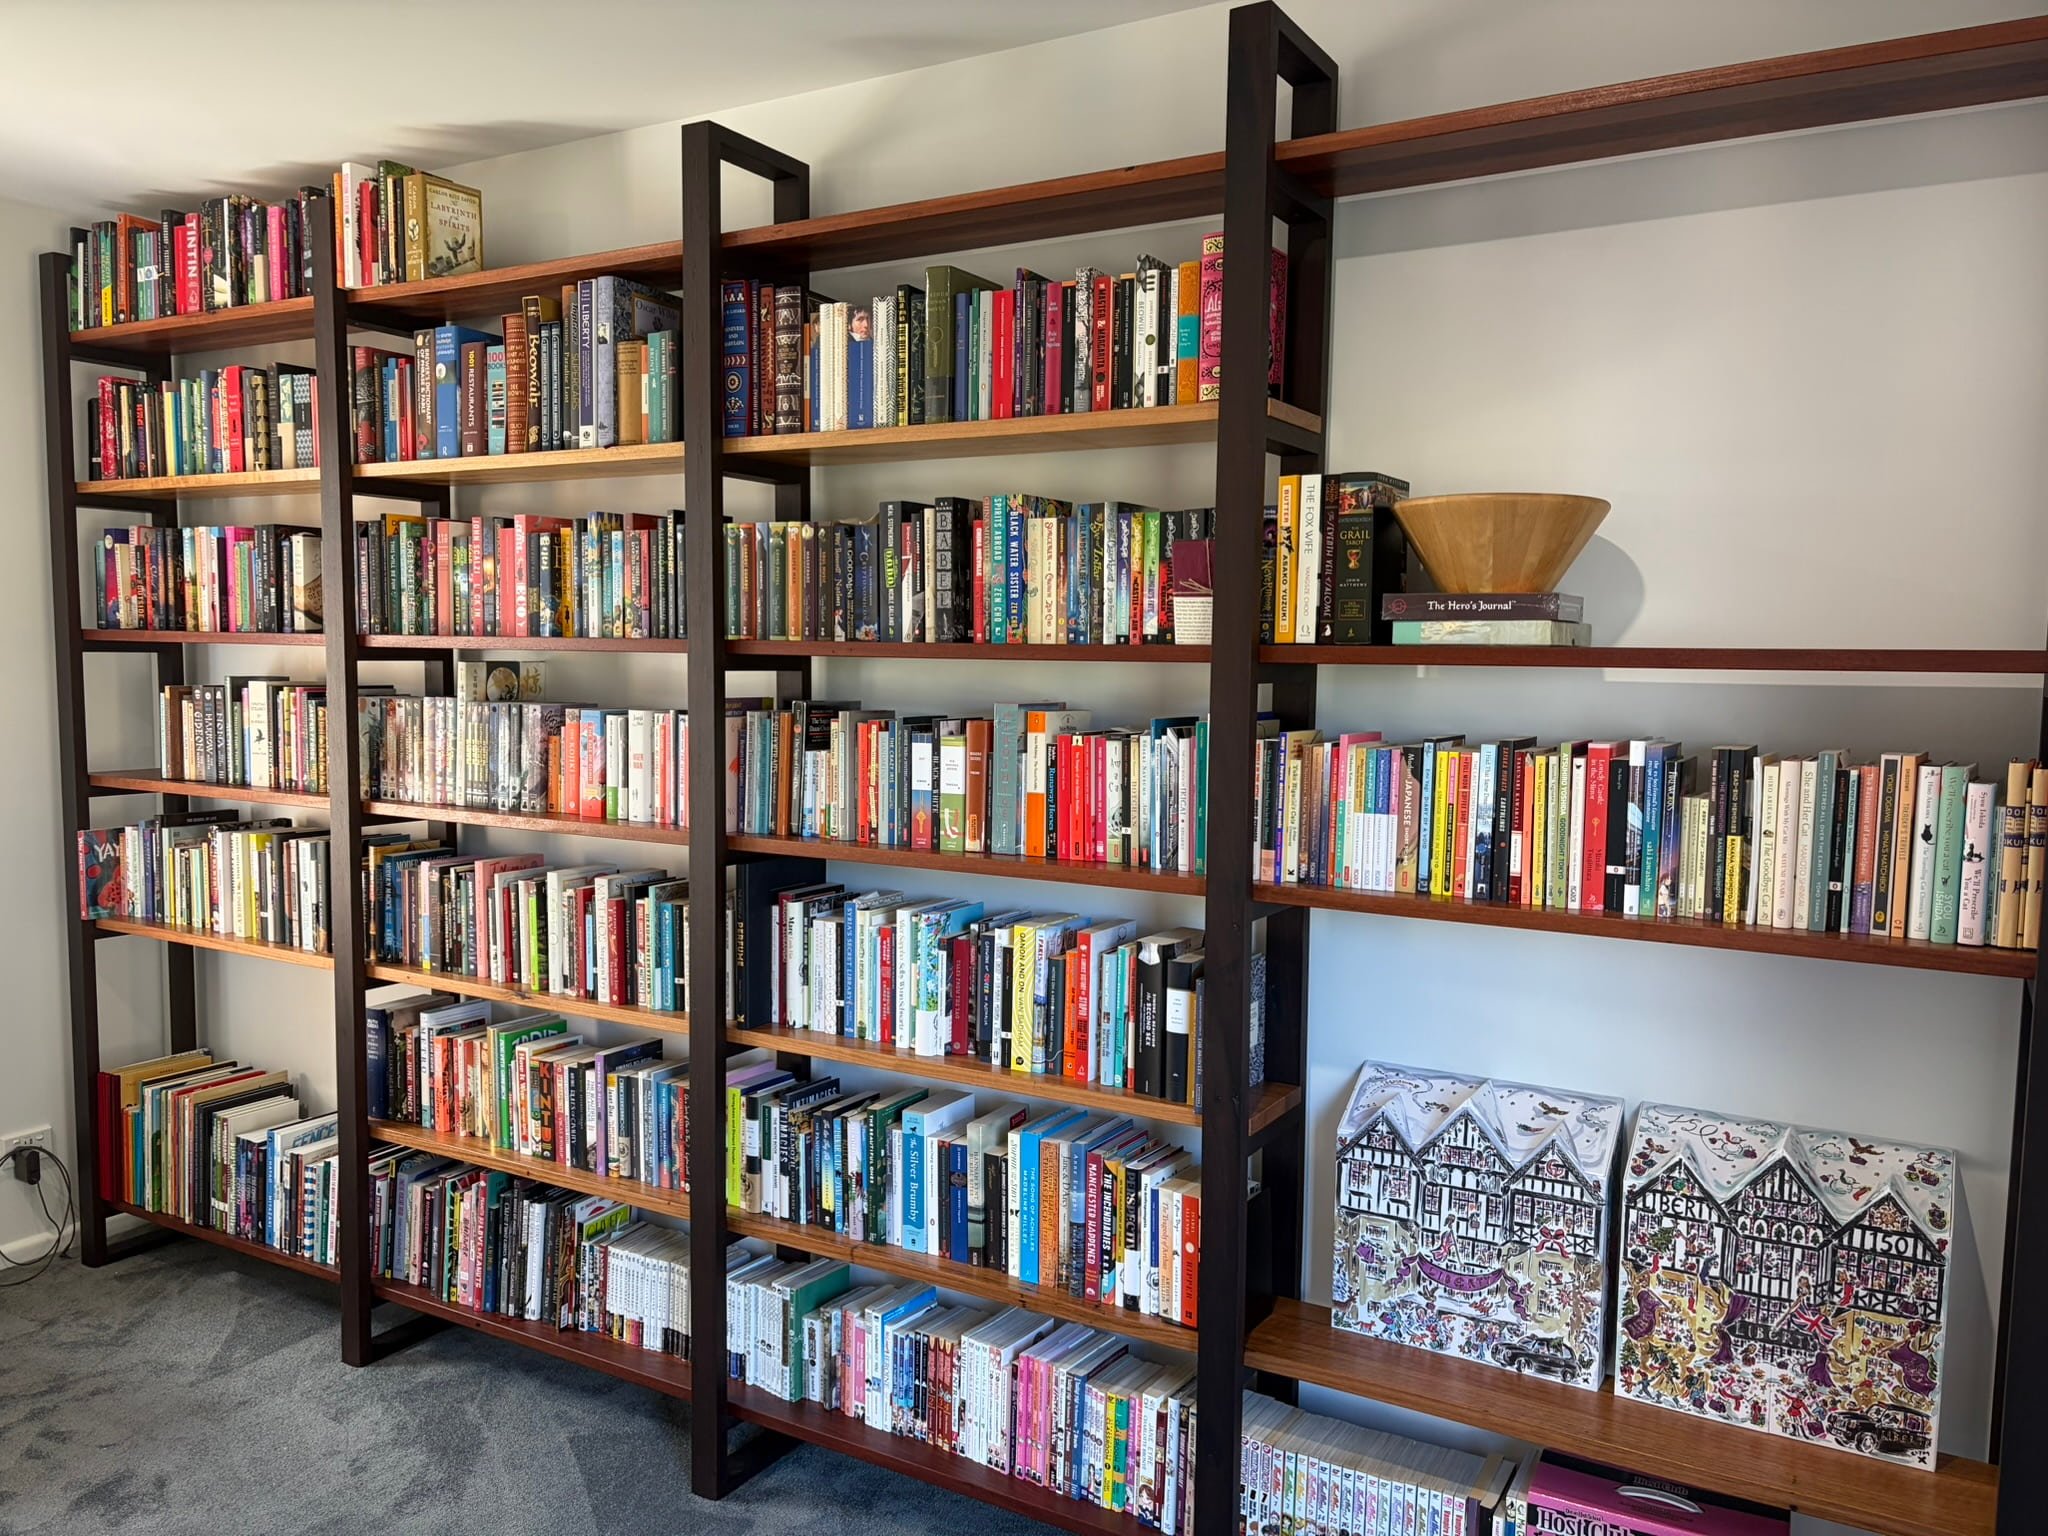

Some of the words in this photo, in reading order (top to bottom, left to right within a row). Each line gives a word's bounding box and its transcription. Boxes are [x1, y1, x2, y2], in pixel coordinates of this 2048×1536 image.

[431, 201, 477, 220] LABYRINTH
[439, 219, 470, 232] SPIRITS
[187, 220, 196, 277] TINTIN
[1097, 288, 1106, 319] MASTER
[582, 304, 590, 348] LIBERTY
[1097, 320, 1106, 328] &
[1096, 329, 1105, 368] MARGARITA
[1306, 485, 1315, 503] THE
[994, 498, 1002, 528] SPIRITS
[1010, 511, 1019, 536] BLACK
[1305, 507, 1314, 527] FOX
[994, 531, 1002, 560] ABROAD
[1304, 530, 1313, 555] WIFE
[1340, 530, 1370, 540] GRAIL
[1010, 541, 1019, 567] WATER
[835, 579, 843, 607] Nation
[994, 588, 1002, 603] ZEN
[1010, 572, 1019, 599] SISTER
[994, 607, 1002, 622] CHO
[1427, 600, 1444, 610] The
[1448, 601, 1477, 611] Hero's
[1560, 752, 1568, 785] ATSUHIRO
[1597, 759, 1605, 781] Lonely
[1804, 771, 1814, 787] She
[1731, 770, 1740, 802] DEAD-END
[1803, 788, 1812, 804] and
[1886, 773, 1894, 794] YOKO
[1403, 779, 1413, 826] JAPANESE
[1802, 806, 1811, 822] Her
[1864, 788, 1872, 823] Restaurant
[1884, 796, 1893, 823] OGAWA
[1558, 818, 1566, 857] GOODNIGHT
[1801, 823, 1810, 837] Cat
[1862, 834, 1870, 847] Lost
[1764, 842, 1773, 856] The
[1558, 858, 1566, 879] TOKYO
[1645, 857, 1653, 892] kawashiro
[1761, 858, 1771, 893] Goodbye
[1860, 849, 1869, 876] Recipes
[1879, 854, 1890, 893] MATCHBOX
[1727, 865, 1735, 898] YOSHIMOTO
[1762, 894, 1770, 907] Cat
[1934, 890, 1944, 921] ISHIDA
[1945, 894, 1954, 920] SYOU
[1018, 981, 1024, 993] ON
[780, 1102, 788, 1163] INTIMACIES
[909, 1150, 918, 1180] Silver
[1087, 1163, 1097, 1219] MANCHESTER
[1104, 1173, 1112, 1189] THE
[908, 1182, 918, 1222] Brumby
[1030, 1205, 1035, 1214] OF
[1642, 1194, 1715, 1217] LIBERTY
[1102, 1192, 1111, 1250] INCENDIARIES
[1161, 1214, 1169, 1241] Tragedy
[1087, 1220, 1096, 1265] HAPPENED
[1867, 1232, 1909, 1256] 150
[1185, 1261, 1193, 1300] RIPPER
[1536, 1509, 1583, 1533] Host
